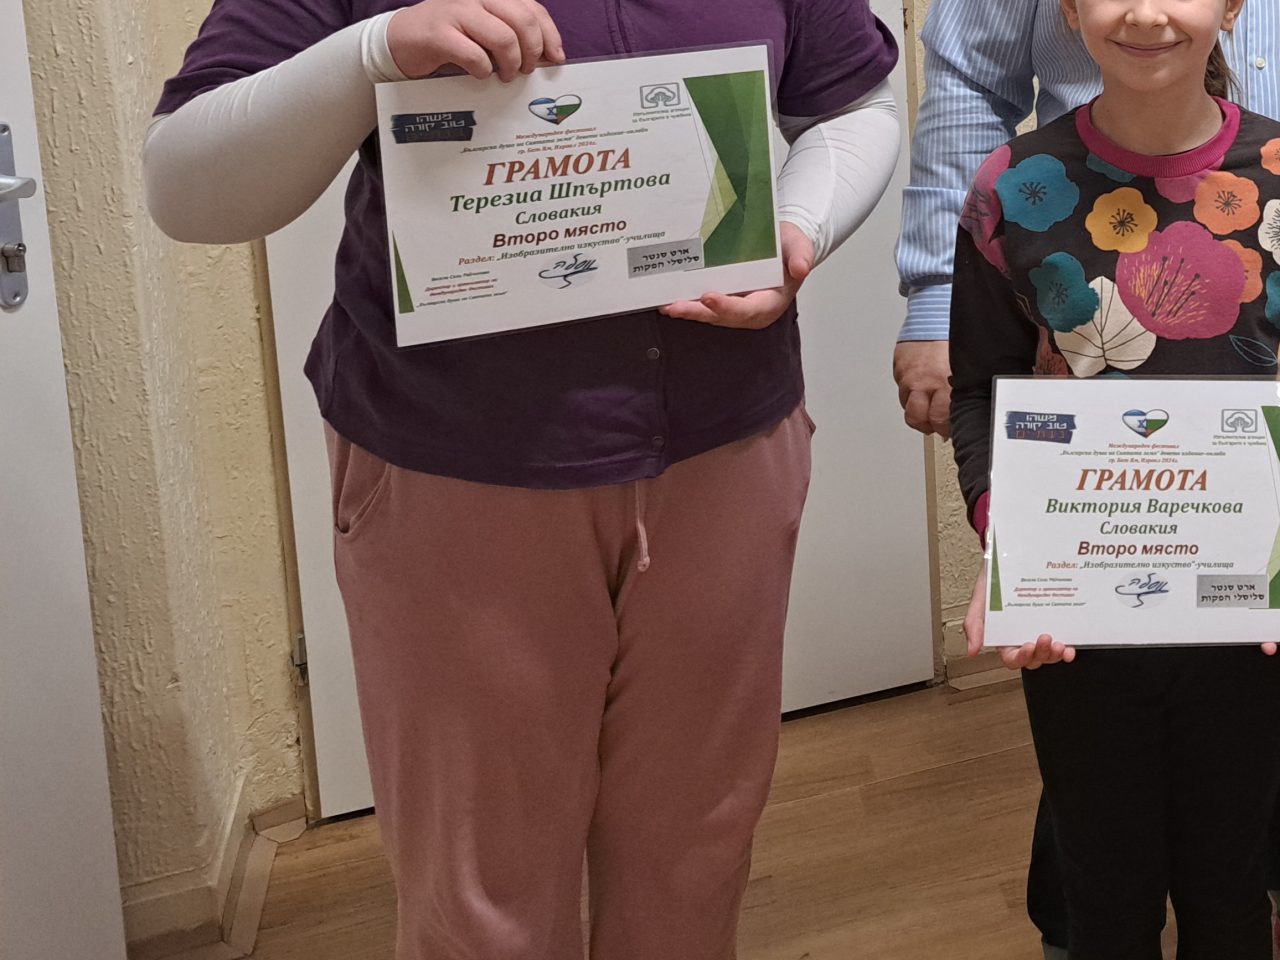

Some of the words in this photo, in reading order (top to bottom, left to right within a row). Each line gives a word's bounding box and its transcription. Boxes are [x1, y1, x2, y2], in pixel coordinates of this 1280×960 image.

[483, 147, 631, 186] ГРАМОТА
[450, 189, 542, 214] Терезиа
[549, 173, 671, 200] Шпъртова
[515, 203, 602, 225] Словакия
[492, 229, 559, 249] Второ
[564, 220, 627, 240] място
[458, 255, 495, 266] Раздел:
[1075, 468, 1208, 491] ГРАМОТА
[1045, 498, 1142, 518] Виктория
[1146, 498, 1243, 518] Варечкова
[1100, 520, 1178, 535] Словакия
[1077, 541, 1138, 559] Второ
[1141, 543, 1200, 556] място
[1046, 561, 1079, 570] Раздел:
